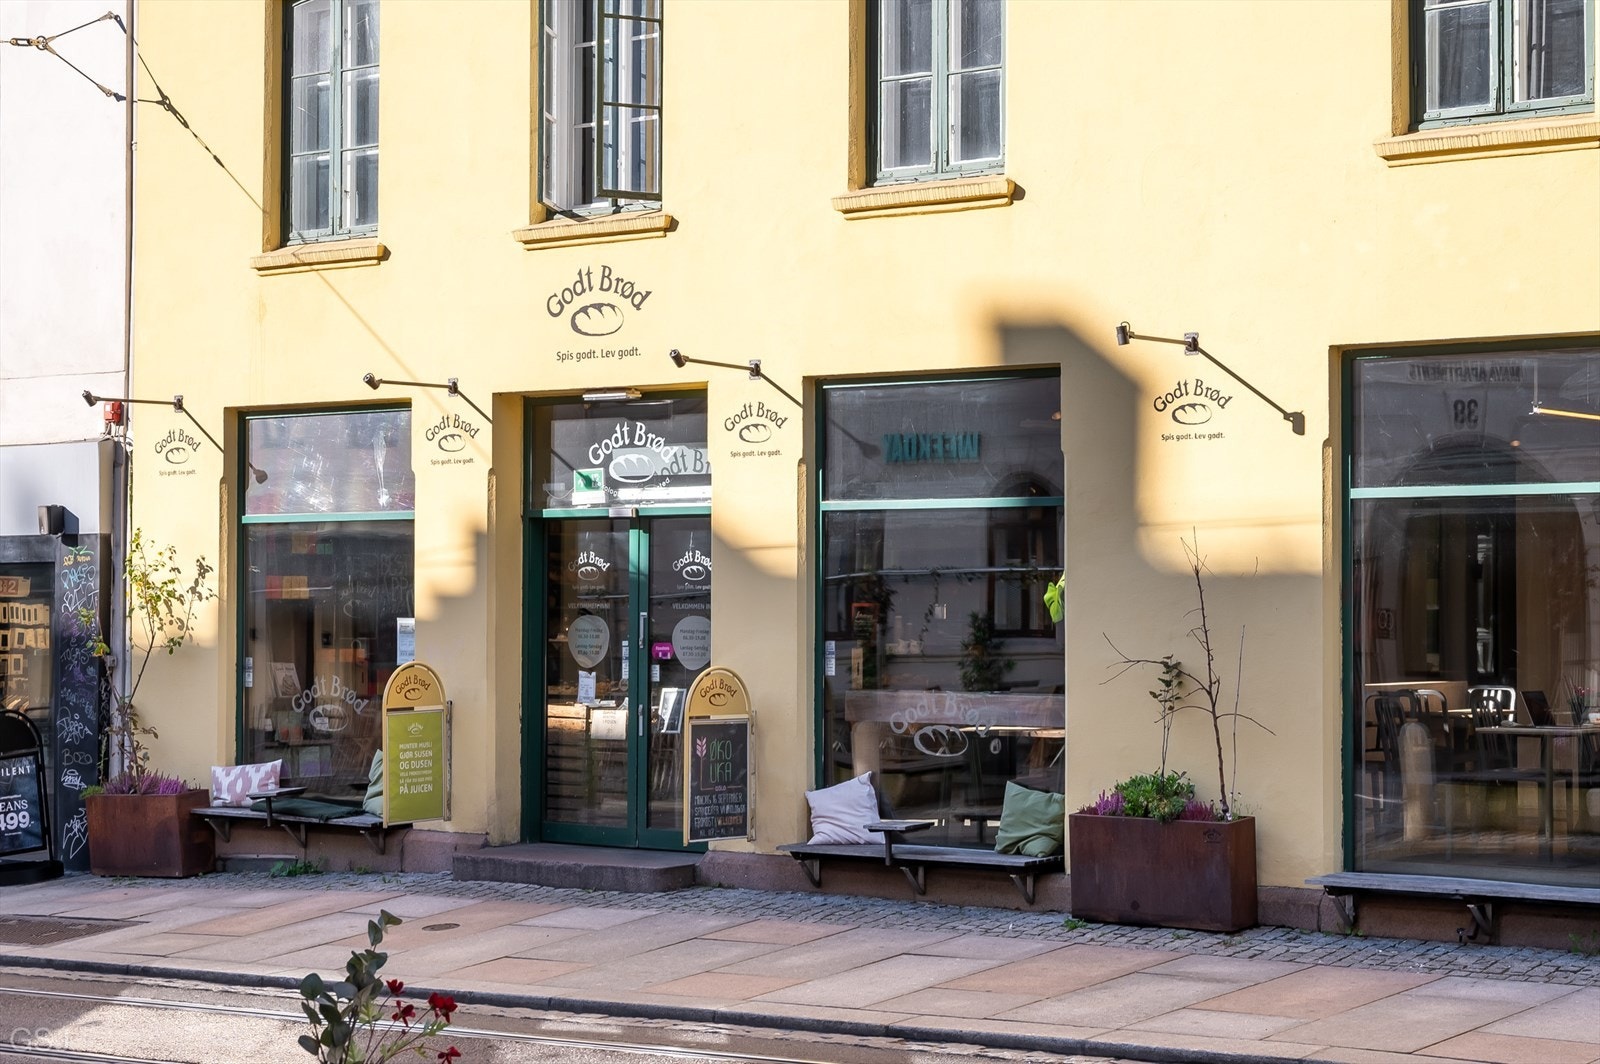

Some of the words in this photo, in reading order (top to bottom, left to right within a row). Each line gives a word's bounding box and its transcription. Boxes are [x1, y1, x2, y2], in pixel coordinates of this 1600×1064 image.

[547, 265, 594, 318] Godt
[599, 264, 653, 311] Brød
[556, 351, 574, 363] Spis
[576, 349, 599, 362] godt.
[601, 348, 616, 358] Lev
[618, 346, 641, 360] godt.
[1153, 379, 1190, 413] Godt
[1193, 378, 1233, 410] Brød
[425, 413, 450, 442] Godt
[453, 413, 480, 439] Brød
[724, 401, 753, 432] Godt
[756, 401, 788, 429] Brød
[154, 428, 176, 454] Godt
[178, 428, 201, 452] Brød
[588, 421, 630, 465] Godt
[633, 421, 680, 463] Brød
[1161, 433, 1175, 442] Spis
[654, 448, 689, 476] odt
[568, 551, 588, 572] Godt
[588, 551, 611, 572] Brød
[672, 550, 694, 571] Godt
[291, 675, 327, 713] Godt
[330, 674, 370, 715] Brød
[395, 675, 412, 694] Godt
[413, 674, 431, 691] Brød
[700, 679, 717, 698] Godt
[718, 679, 738, 698] Brød
[890, 689, 940, 734] Godt
[400, 751, 414, 759] GJØR
[414, 750, 433, 758] SUSEN
[709, 738, 733, 761] ØKO
[400, 760, 410, 770] OG
[411, 759, 433, 769] DUSEN
[709, 761, 733, 783] UKA
[400, 784, 409, 795] PÅ
[410, 783, 433, 793] JUICEN
